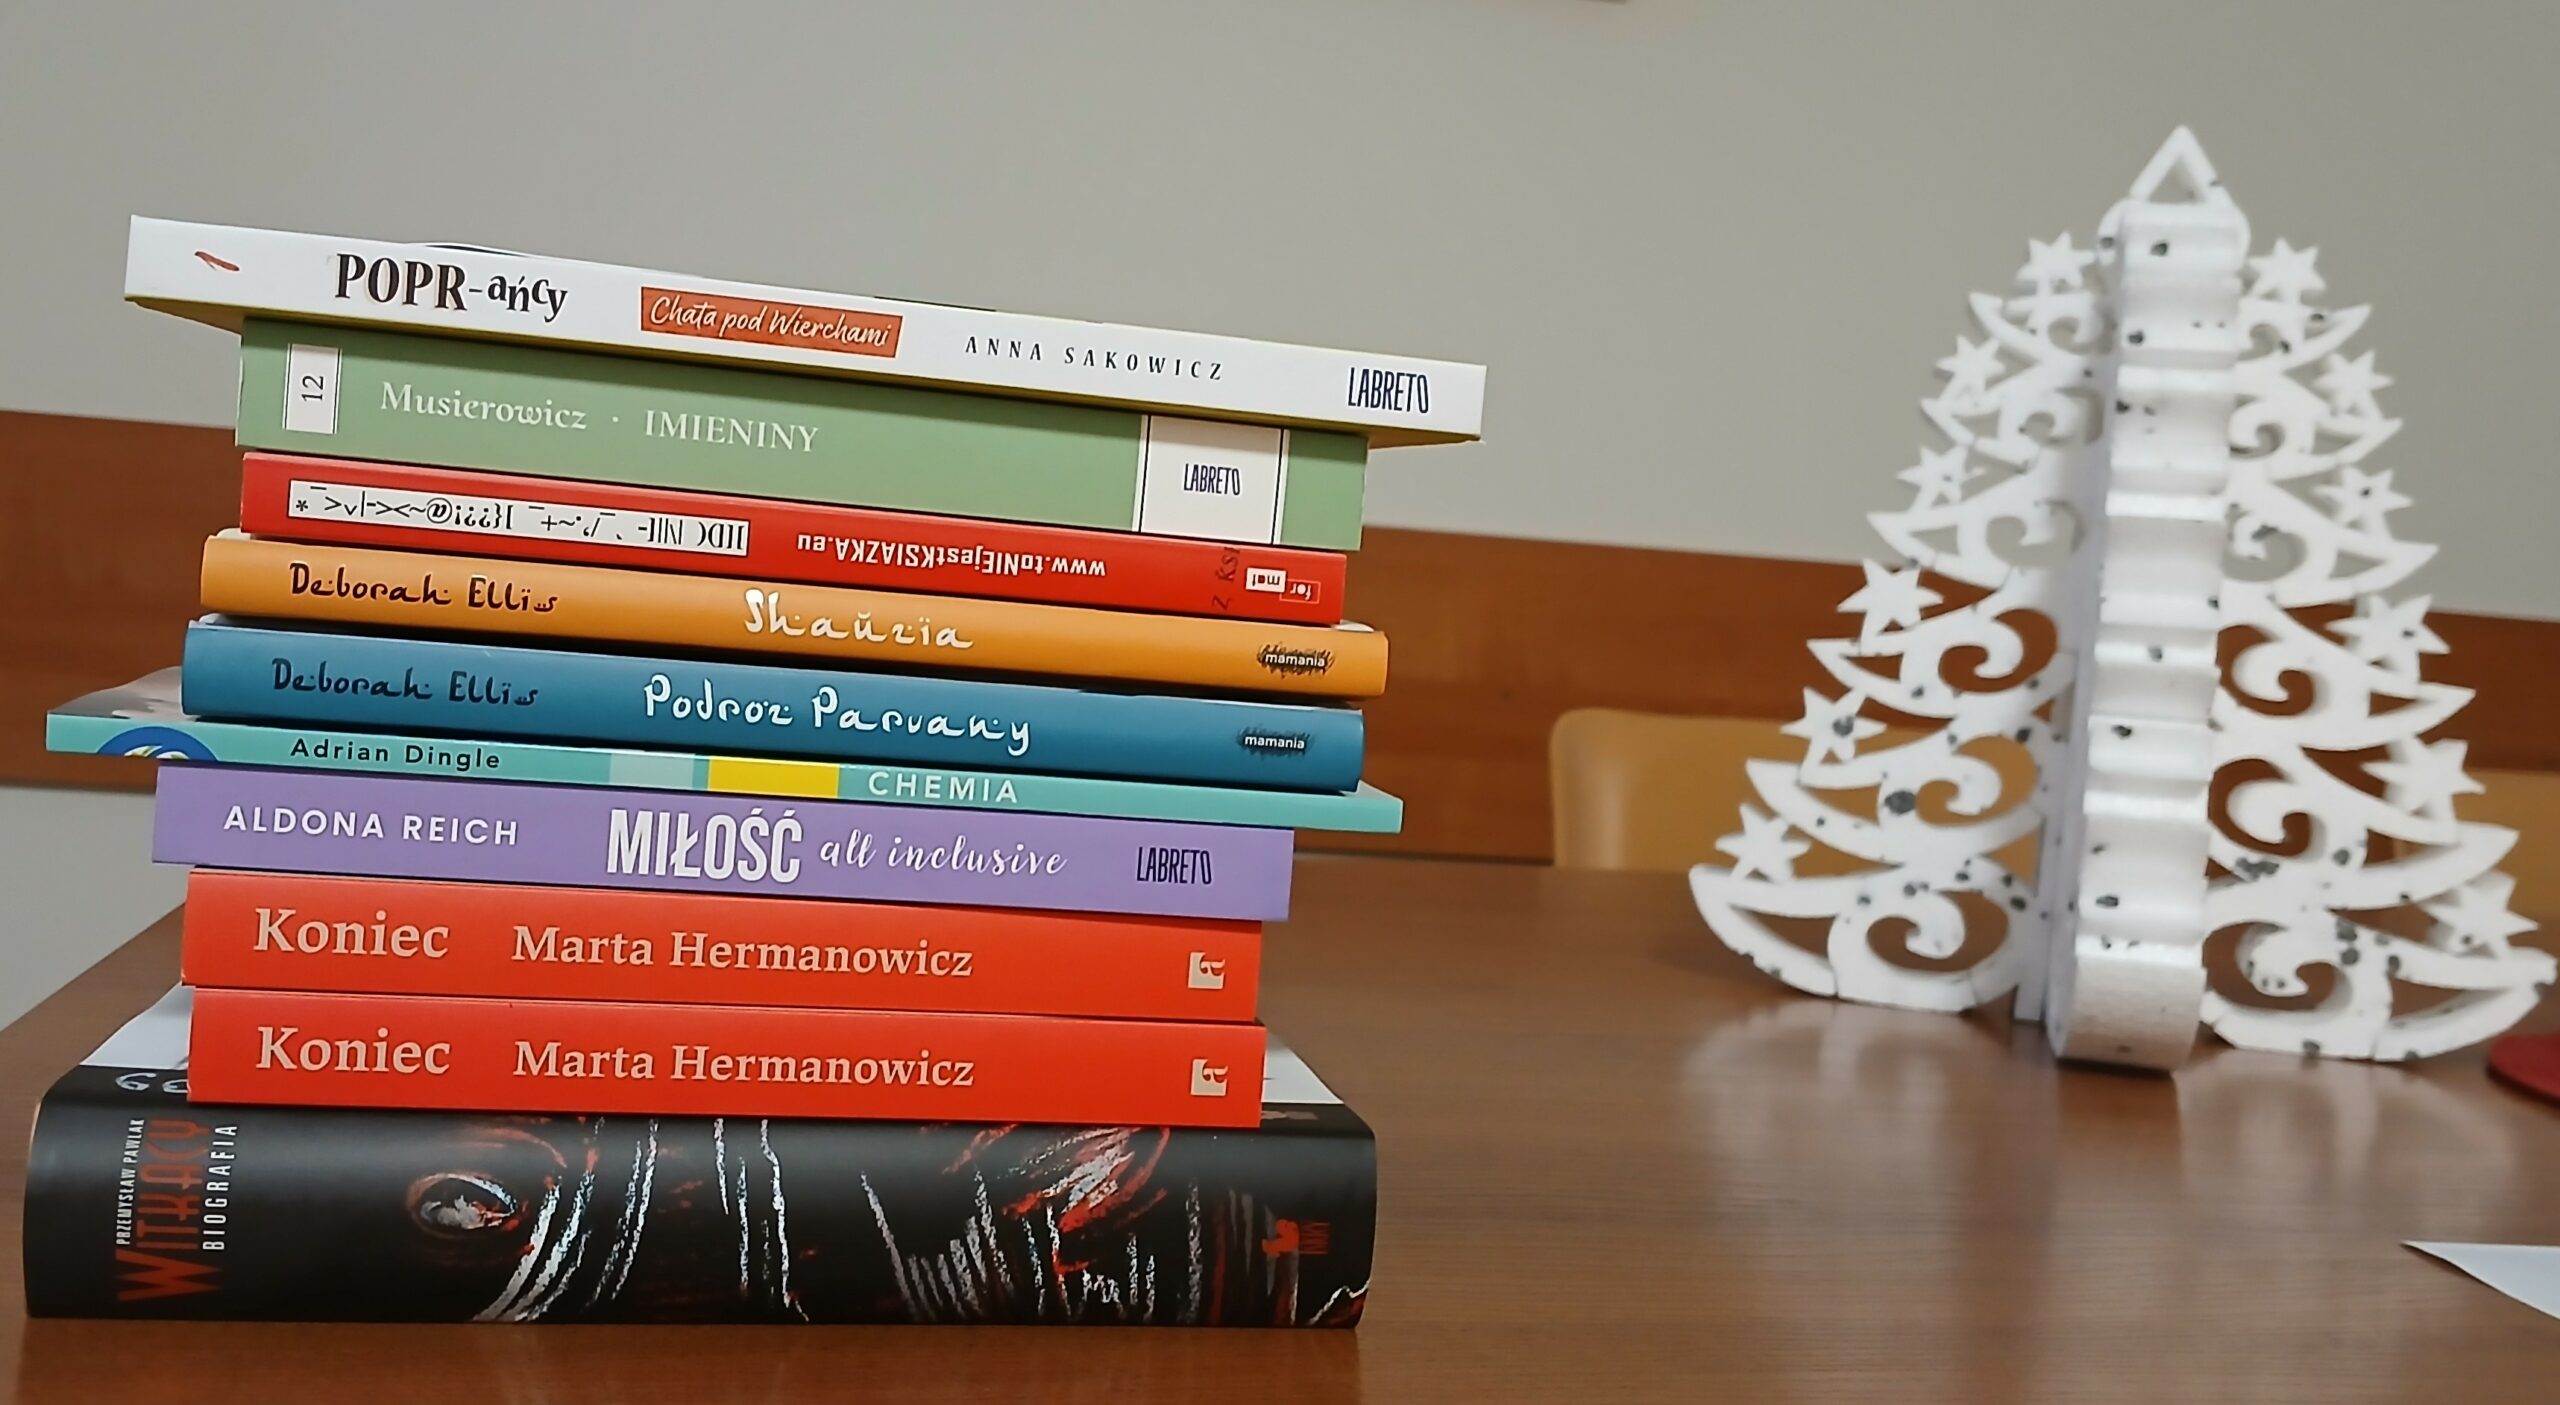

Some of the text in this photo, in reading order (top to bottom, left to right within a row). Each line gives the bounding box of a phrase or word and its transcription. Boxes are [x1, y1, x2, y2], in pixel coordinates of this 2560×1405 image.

[335, 253, 568, 323] POPR-ańcy
[650, 295, 893, 347] Chata pod Wierchami
[965, 335, 1224, 381] ANNA SAKOWICZ
[301, 373, 325, 403] 12
[380, 380, 588, 430] Musierowicz
[1347, 366, 1430, 414] LABRETO
[644, 410, 819, 453] IMIENINY
[1183, 463, 1241, 497] LABRETO
[797, 533, 1107, 577] www.toNIEjestKSIAZKA.eu
[289, 561, 559, 614] Deborah Ellis
[1289, 583, 1313, 600] for
[272, 657, 539, 706] Deborah Ellis
[1265, 653, 1326, 668] mamania
[811, 686, 1031, 757] Parvany
[1244, 735, 1306, 750] mamania
[290, 737, 501, 773] Adrian Dingle
[868, 770, 1019, 805] CHEMIA
[223, 804, 518, 846] ALDONA REICH
[606, 807, 1068, 884] MIŁOŚĆ all inclusive
[1136, 845, 1213, 886] LABRETO
[252, 908, 974, 978] Koniec Marta Hermanowicz
[256, 1026, 975, 1088] Koniec Marta Hermanowicz
[116, 1119, 145, 1245] PRZEMYSŁAW PAWLAK
[202, 1125, 237, 1250] BIOGRAFIA
[115, 1119, 223, 1303] WITKACY
